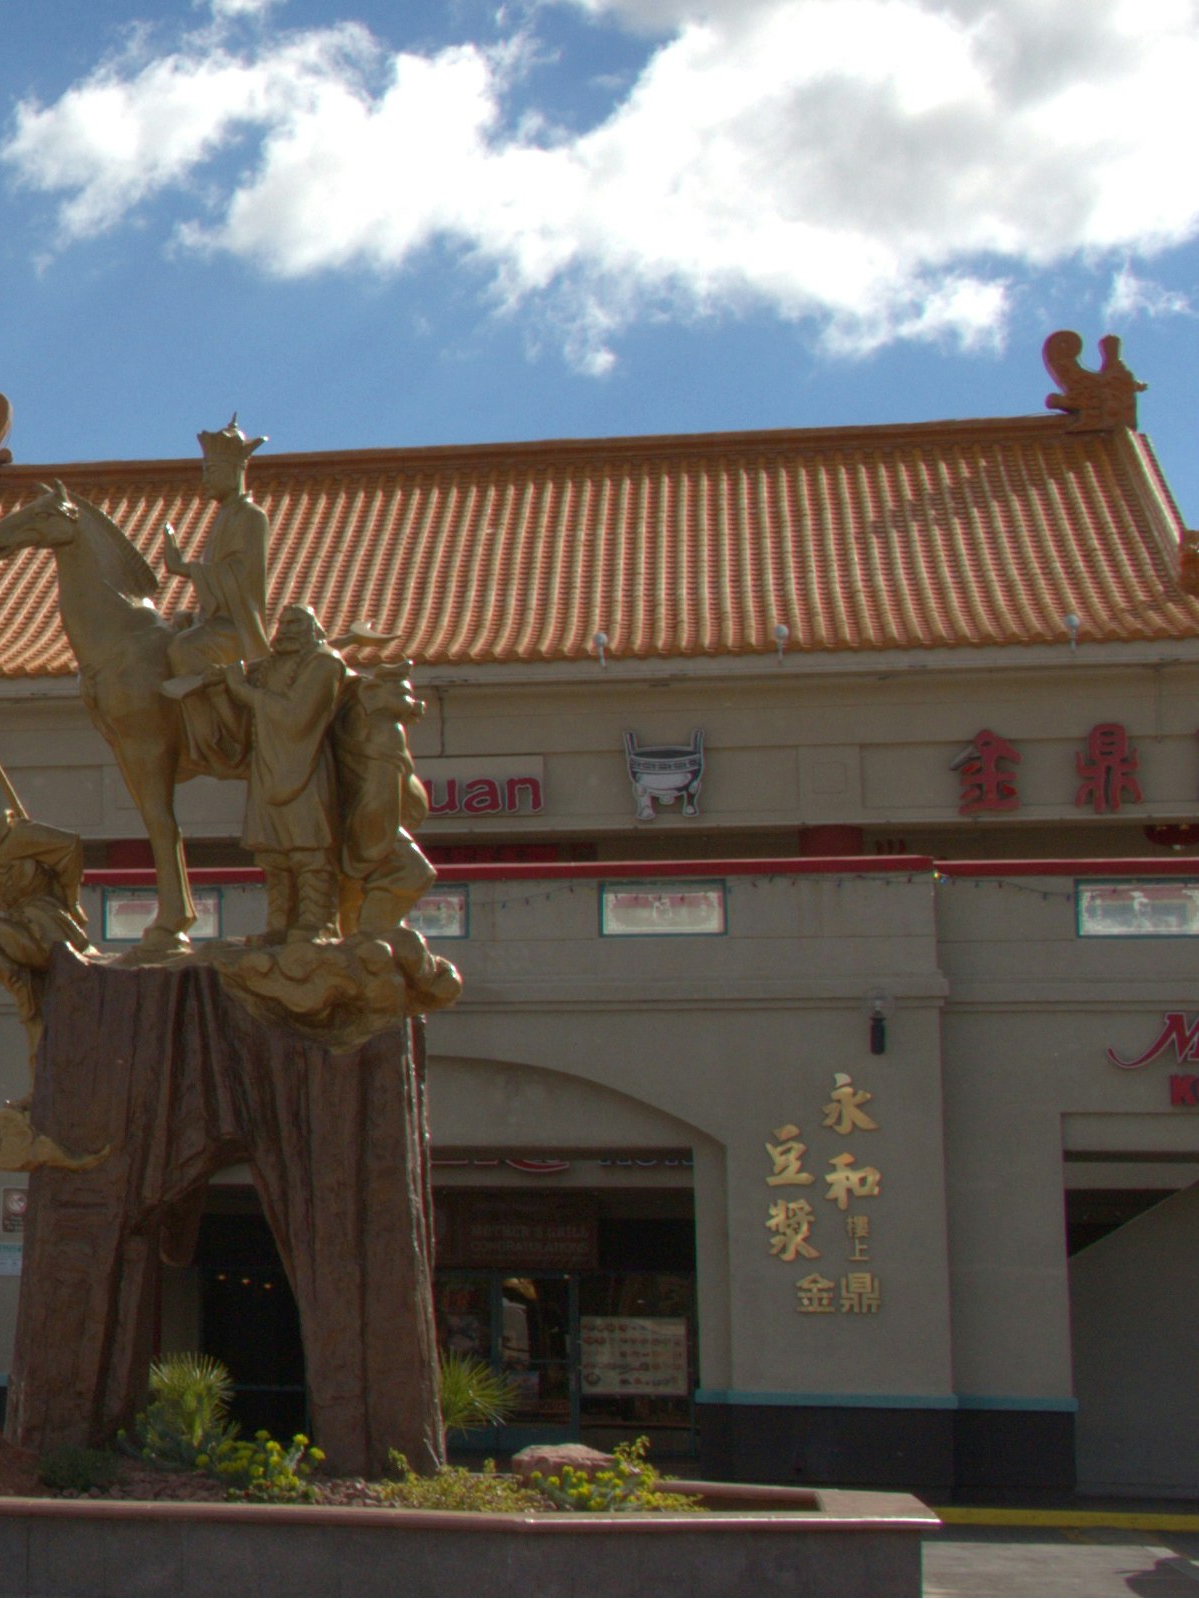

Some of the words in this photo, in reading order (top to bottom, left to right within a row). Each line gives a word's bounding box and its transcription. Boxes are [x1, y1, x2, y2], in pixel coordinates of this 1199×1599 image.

[949, 722, 1199, 815] 金鼎
[423, 775, 545, 815] uan
[1169, 1074, 1199, 1106] K
[820, 1072, 882, 1211] 永和
[547, 1225, 590, 1239] GRILL
[795, 1272, 882, 1313] 金鼎
